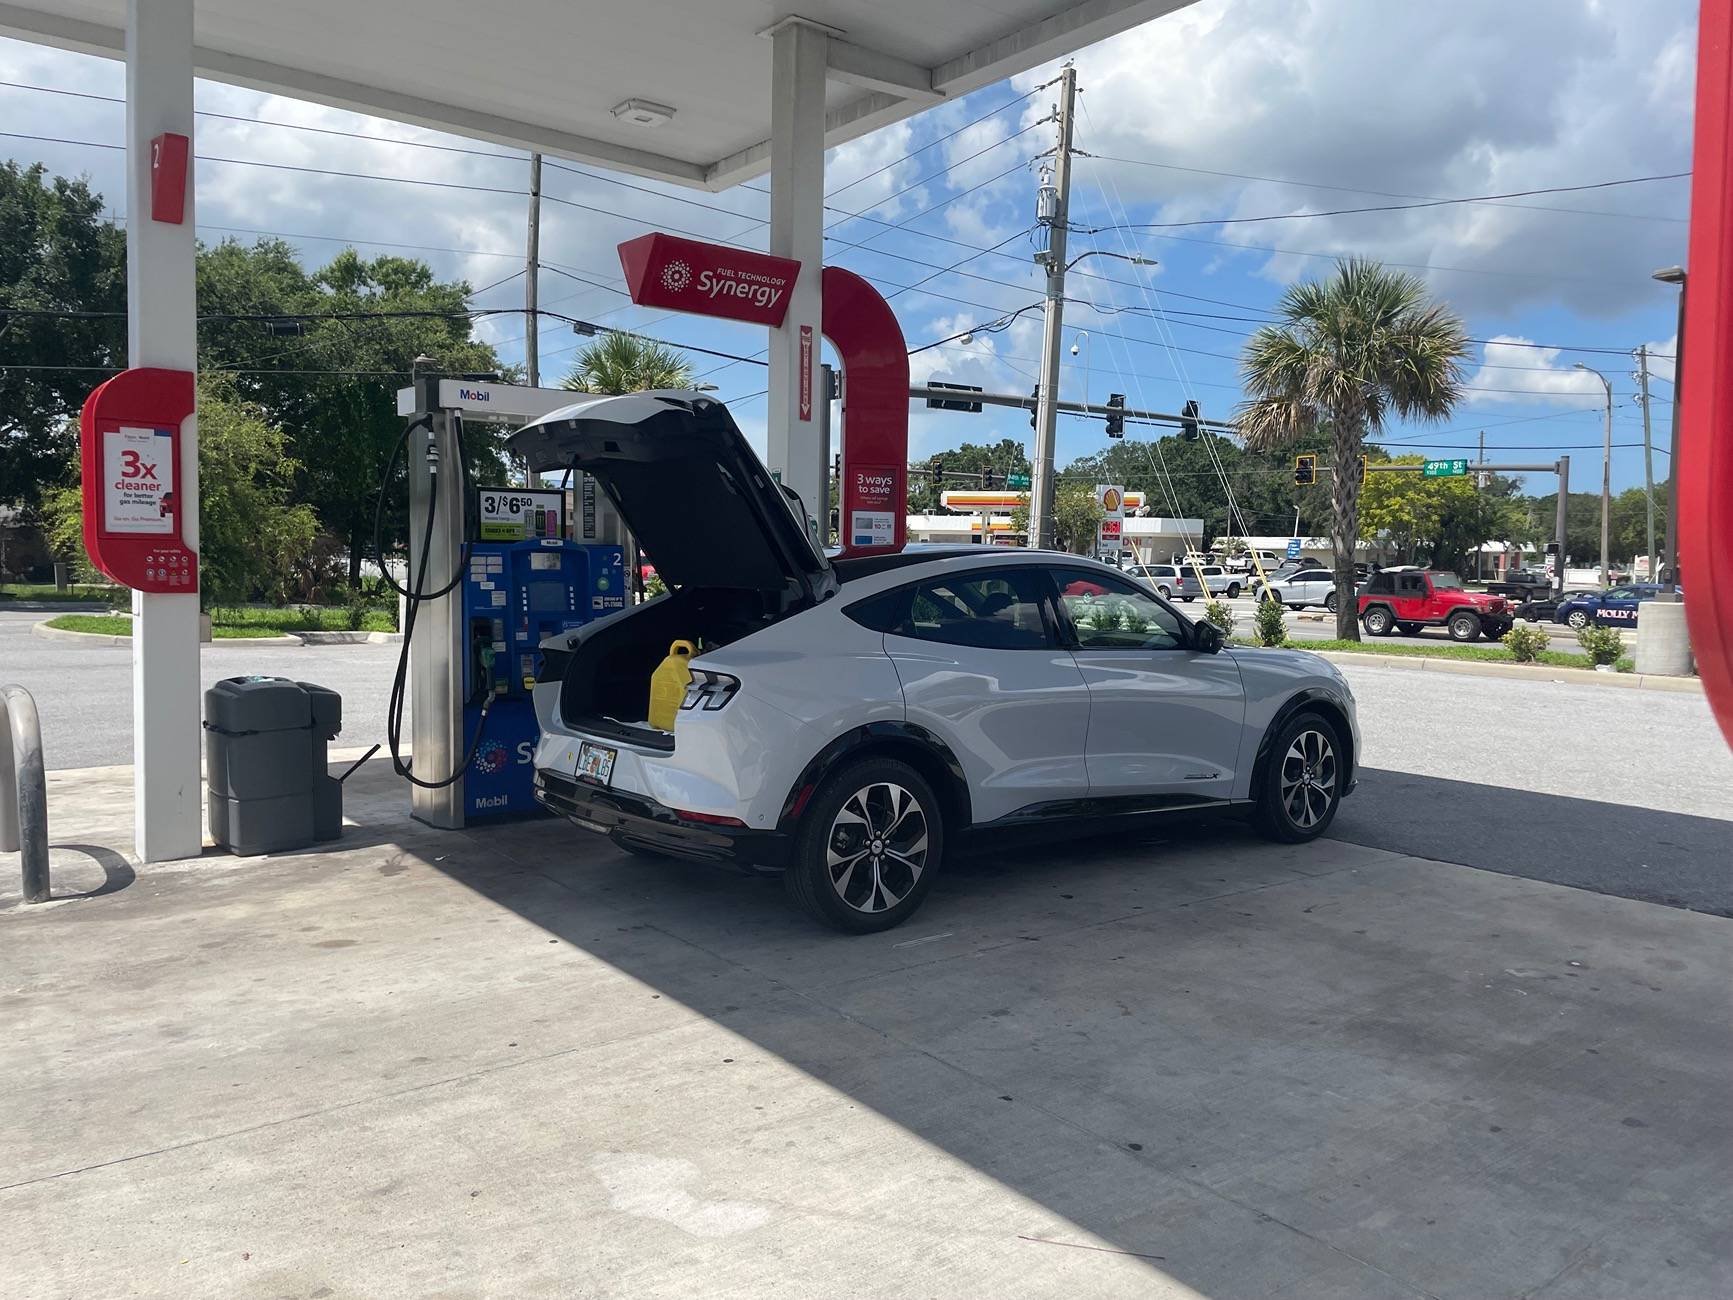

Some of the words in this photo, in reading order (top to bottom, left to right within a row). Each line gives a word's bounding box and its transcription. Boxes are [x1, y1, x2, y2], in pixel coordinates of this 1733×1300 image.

[153, 143, 159, 169] 2
[717, 268, 735, 277] FUEL
[738, 271, 786, 286] TECHNOLOGY
[697, 270, 783, 308] Synergy
[460, 389, 490, 402] Mobil
[121, 450, 158, 480] 3x
[1427, 462, 1449, 470] 49th
[1452, 461, 1463, 470] St
[115, 479, 162, 491] cleaner
[857, 473, 864, 484] 3
[865, 476, 893, 487] ways
[613, 552, 622, 566] 2
[1596, 608, 1628, 619] MOLLY
[475, 794, 508, 809] Mobil
